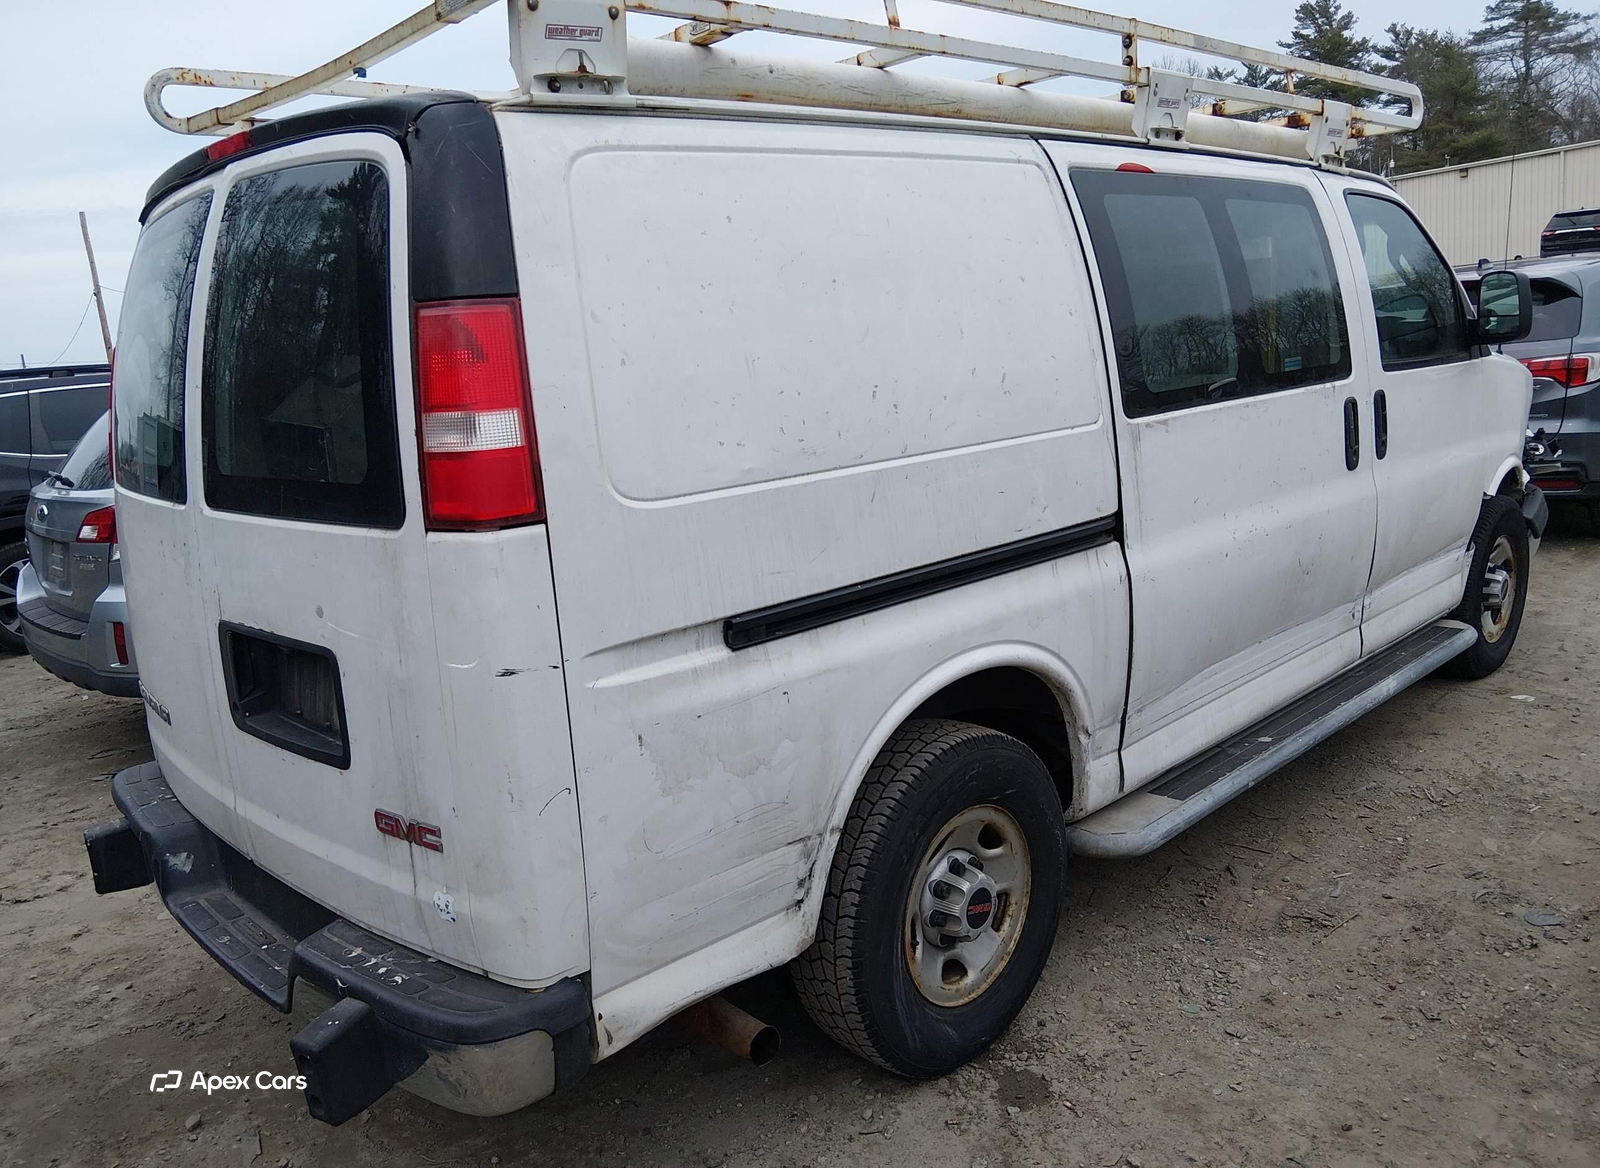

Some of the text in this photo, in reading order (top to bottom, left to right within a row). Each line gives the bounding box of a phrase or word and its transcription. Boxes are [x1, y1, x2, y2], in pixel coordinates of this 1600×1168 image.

[548, 26, 600, 37] weather guard
[374, 808, 444, 853] GMC
[967, 902, 992, 915] GMC
